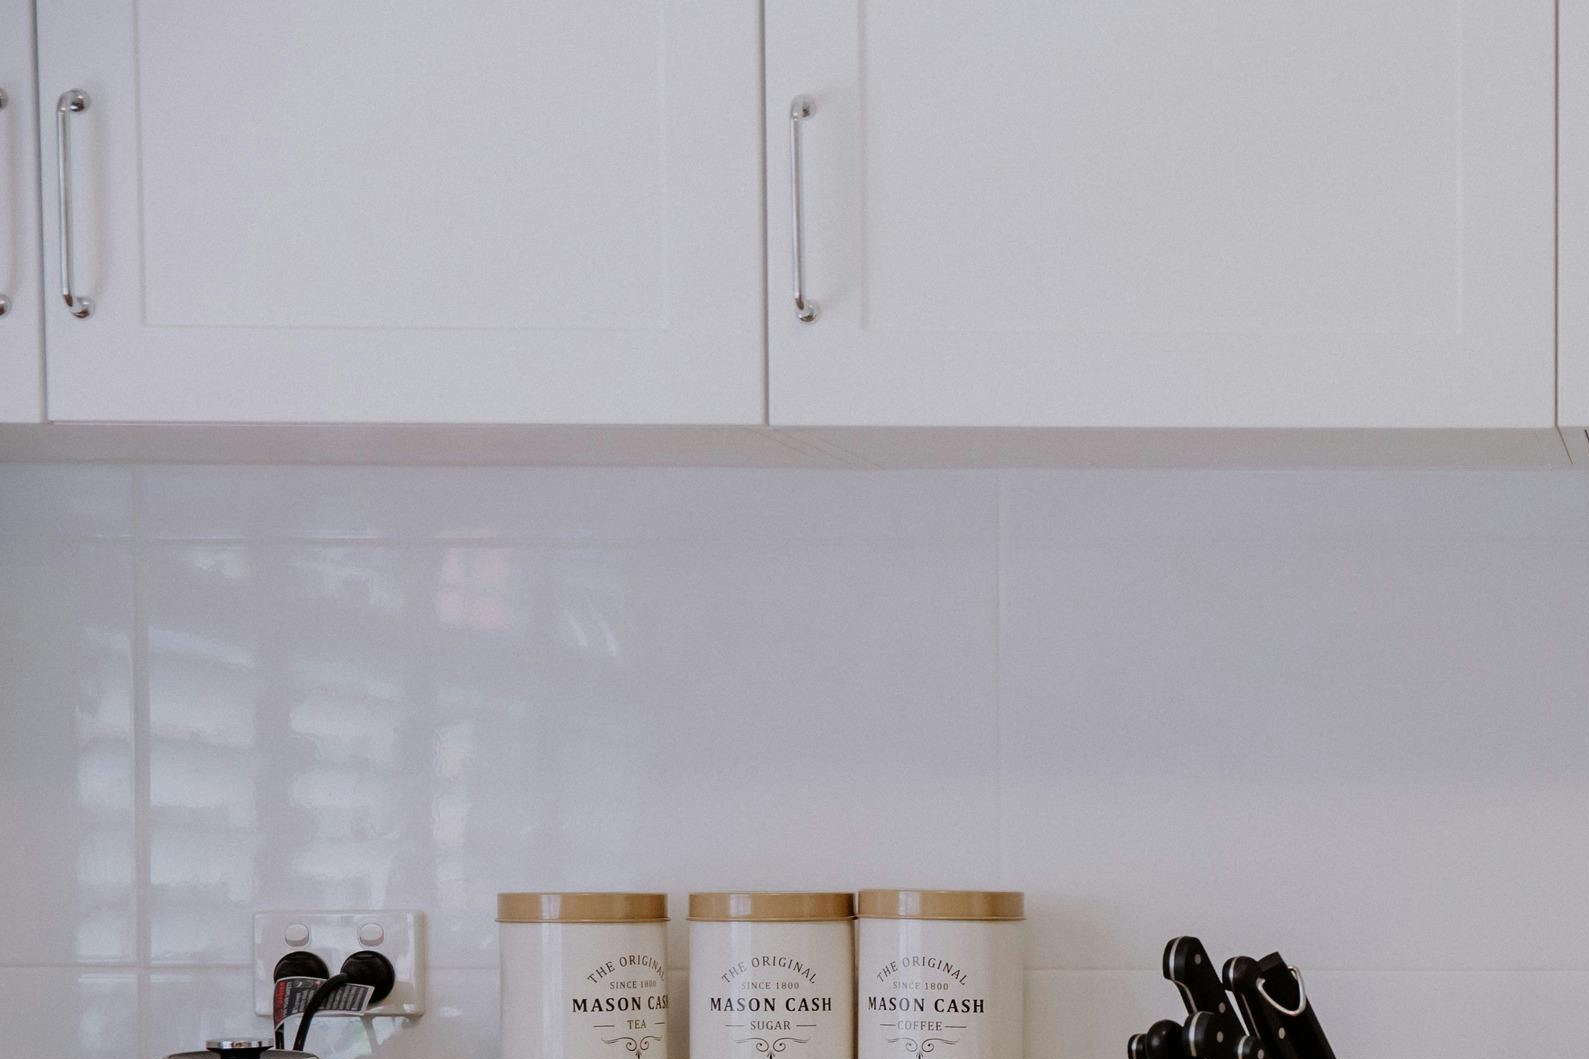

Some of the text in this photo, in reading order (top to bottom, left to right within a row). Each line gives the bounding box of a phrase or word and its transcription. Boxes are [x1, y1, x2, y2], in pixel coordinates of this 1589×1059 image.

[587, 955, 665, 984] THE ORIGINAL
[721, 956, 816, 984] THE ORIGINAL
[877, 956, 967, 985] THE ORIGINAL
[610, 980, 657, 989] SINCE 1800
[893, 981, 949, 990] SINCE 1800
[572, 997, 641, 1012] MASON
[710, 998, 832, 1012] MASON CASH
[868, 997, 984, 1013] MASON CASH
[627, 1020, 647, 1029] TEA
[750, 1021, 791, 1030] SUGAR
[897, 1021, 943, 1031] COFFEE
